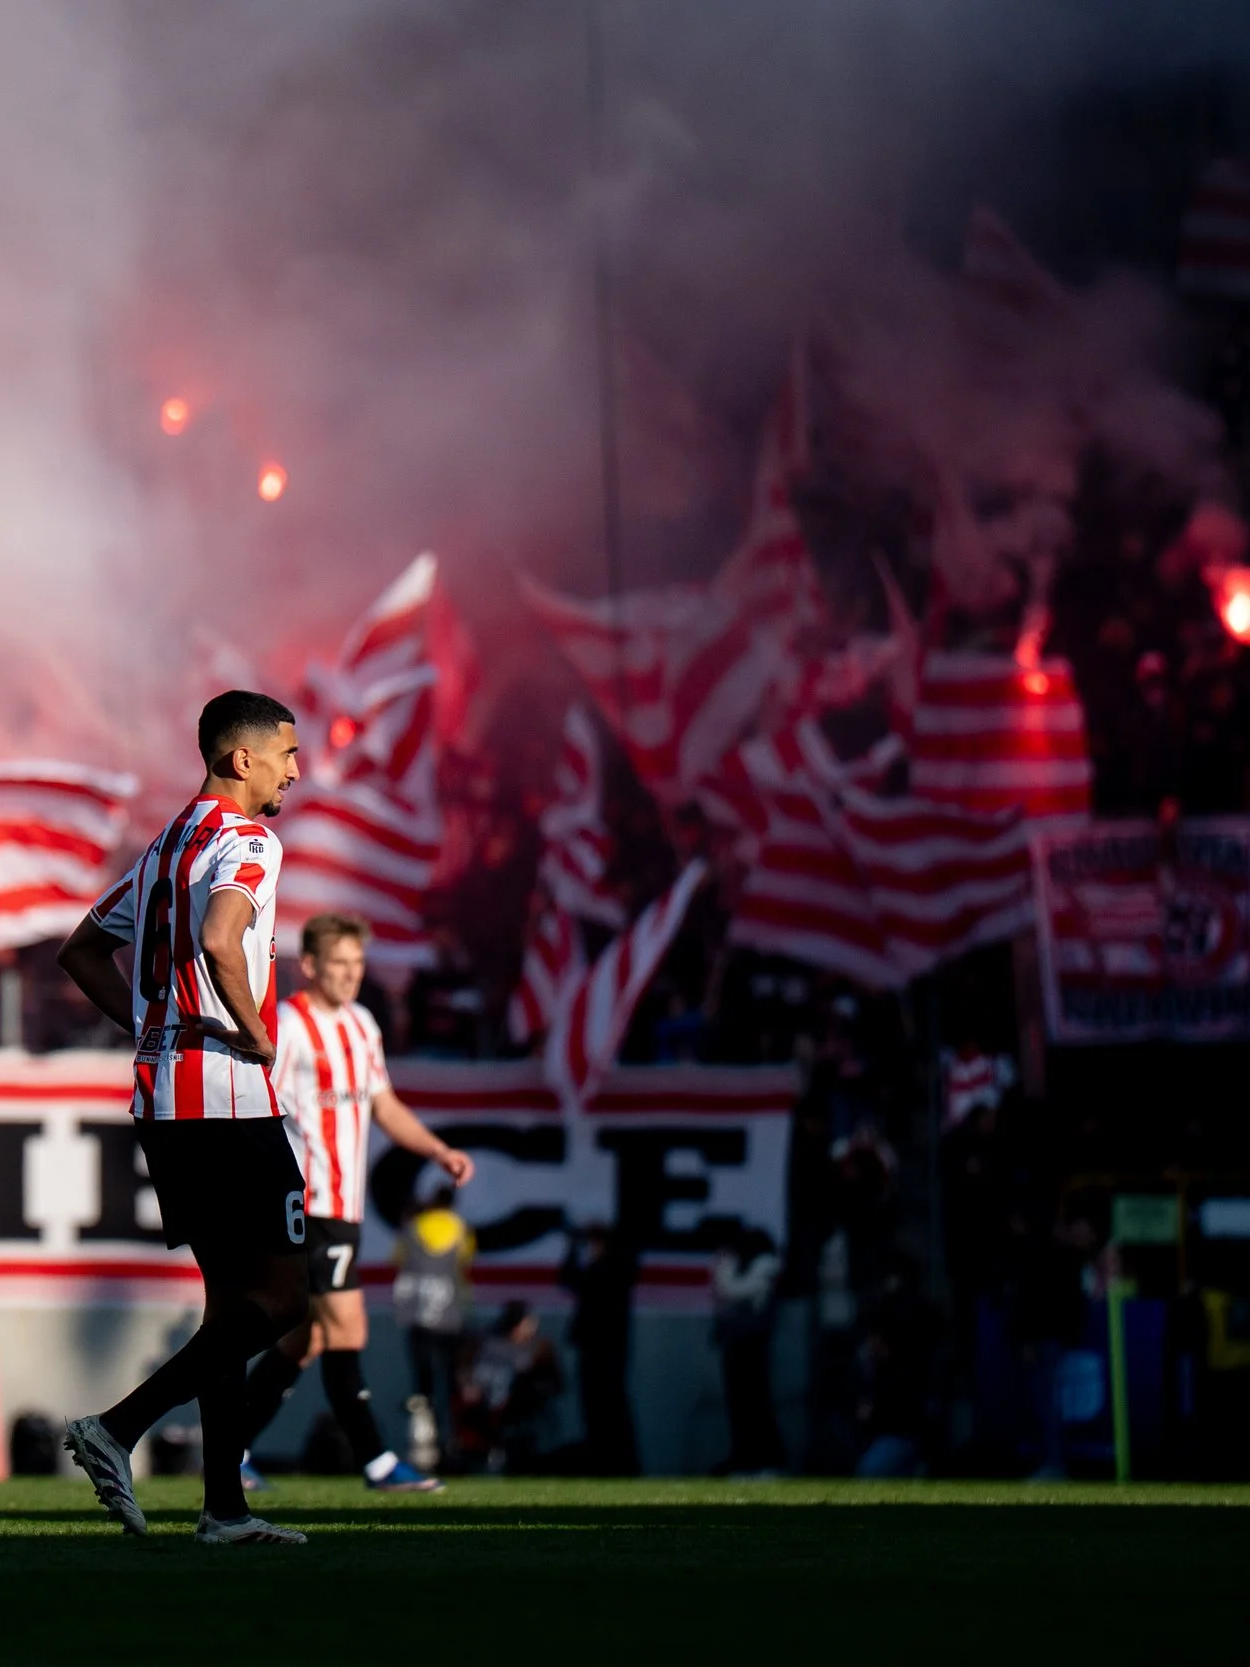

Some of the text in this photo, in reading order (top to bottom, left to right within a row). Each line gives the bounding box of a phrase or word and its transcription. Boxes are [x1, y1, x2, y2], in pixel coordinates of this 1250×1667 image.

[140, 876, 173, 1002] 6
[285, 1191, 306, 1244] 6
[327, 1245, 353, 1287] 7
